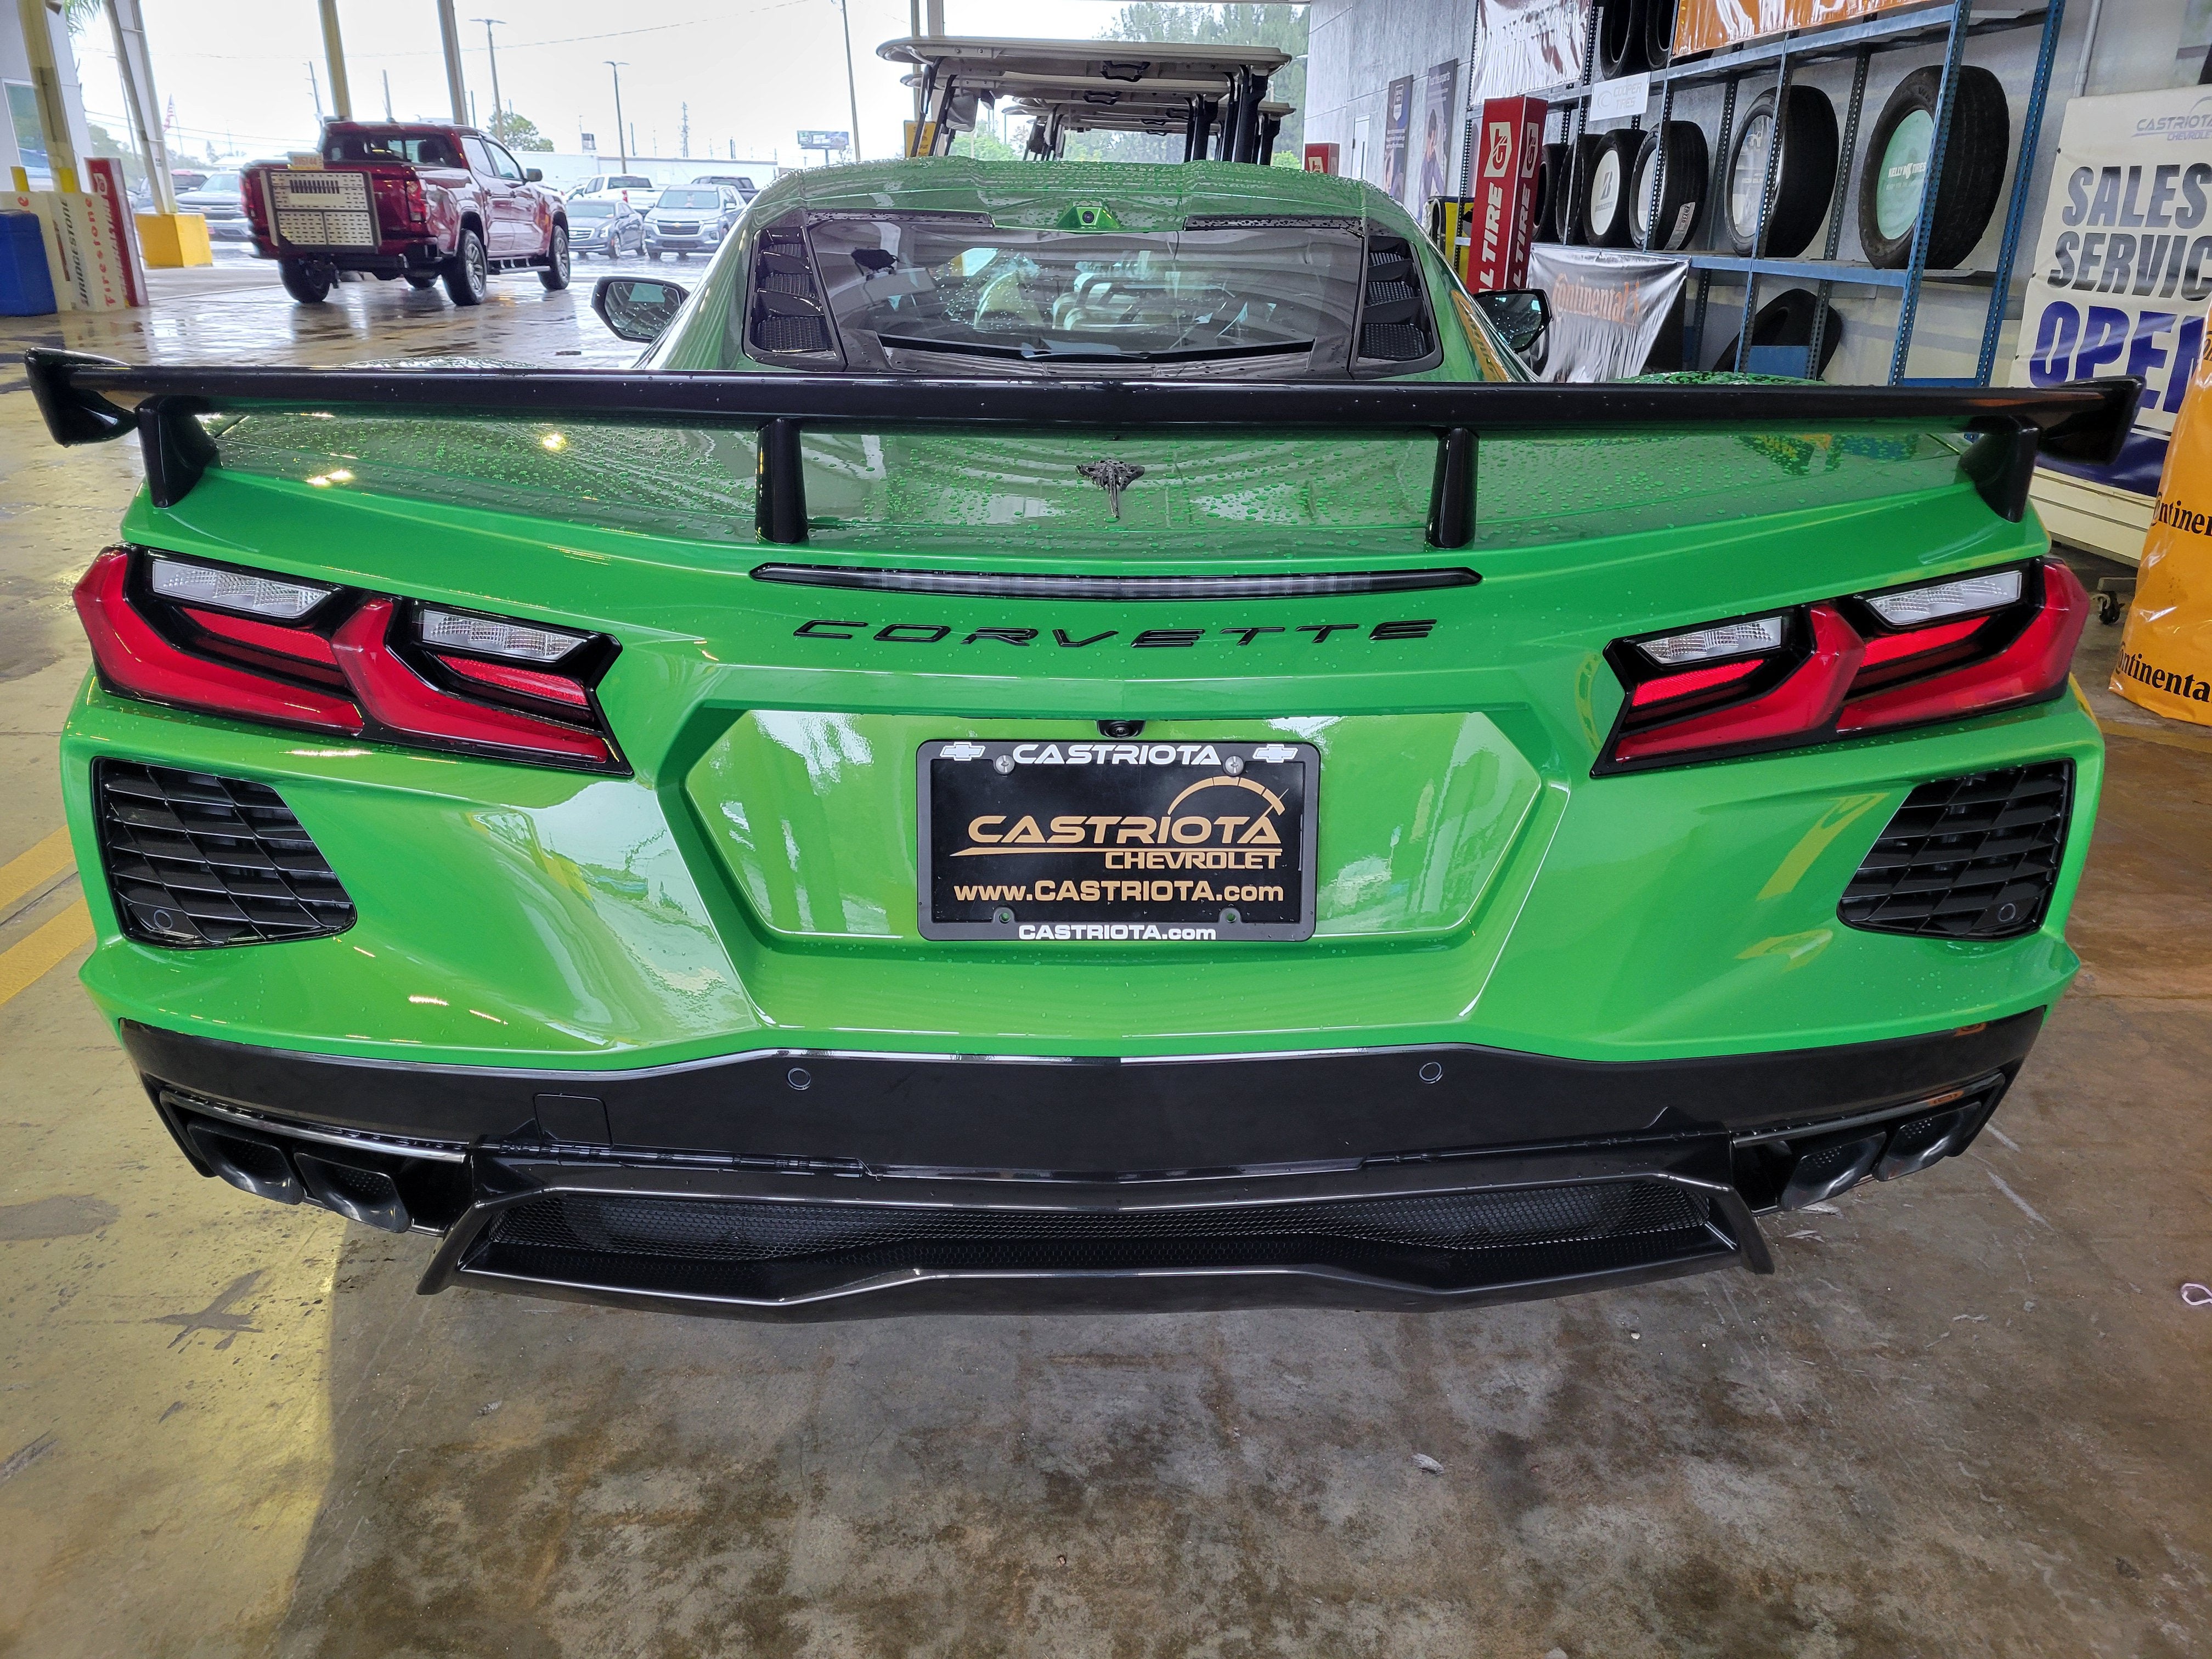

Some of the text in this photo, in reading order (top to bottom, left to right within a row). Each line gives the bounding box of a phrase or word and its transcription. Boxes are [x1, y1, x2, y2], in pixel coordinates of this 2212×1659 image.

[1613, 82, 1642, 97] COOPER
[1616, 97, 1635, 110] TIRES
[2062, 163, 2212, 229] SALES
[1482, 182, 1503, 262] TIRE
[1515, 183, 1531, 263] TIRE
[85, 197, 116, 307] Firestone
[2047, 231, 2212, 301] SERVIC
[1552, 273, 1629, 323] Continental
[793, 619, 1437, 648] CORVETTE
[1013, 743, 1222, 765] CASTRIOTA
[968, 815, 1282, 844] CASTRIOTA
[1105, 851, 1282, 870] CHEVROLET
[954, 881, 1284, 901] www.CASTRIOTA.com
[1019, 924, 1216, 940] CASTRIOTA.com
